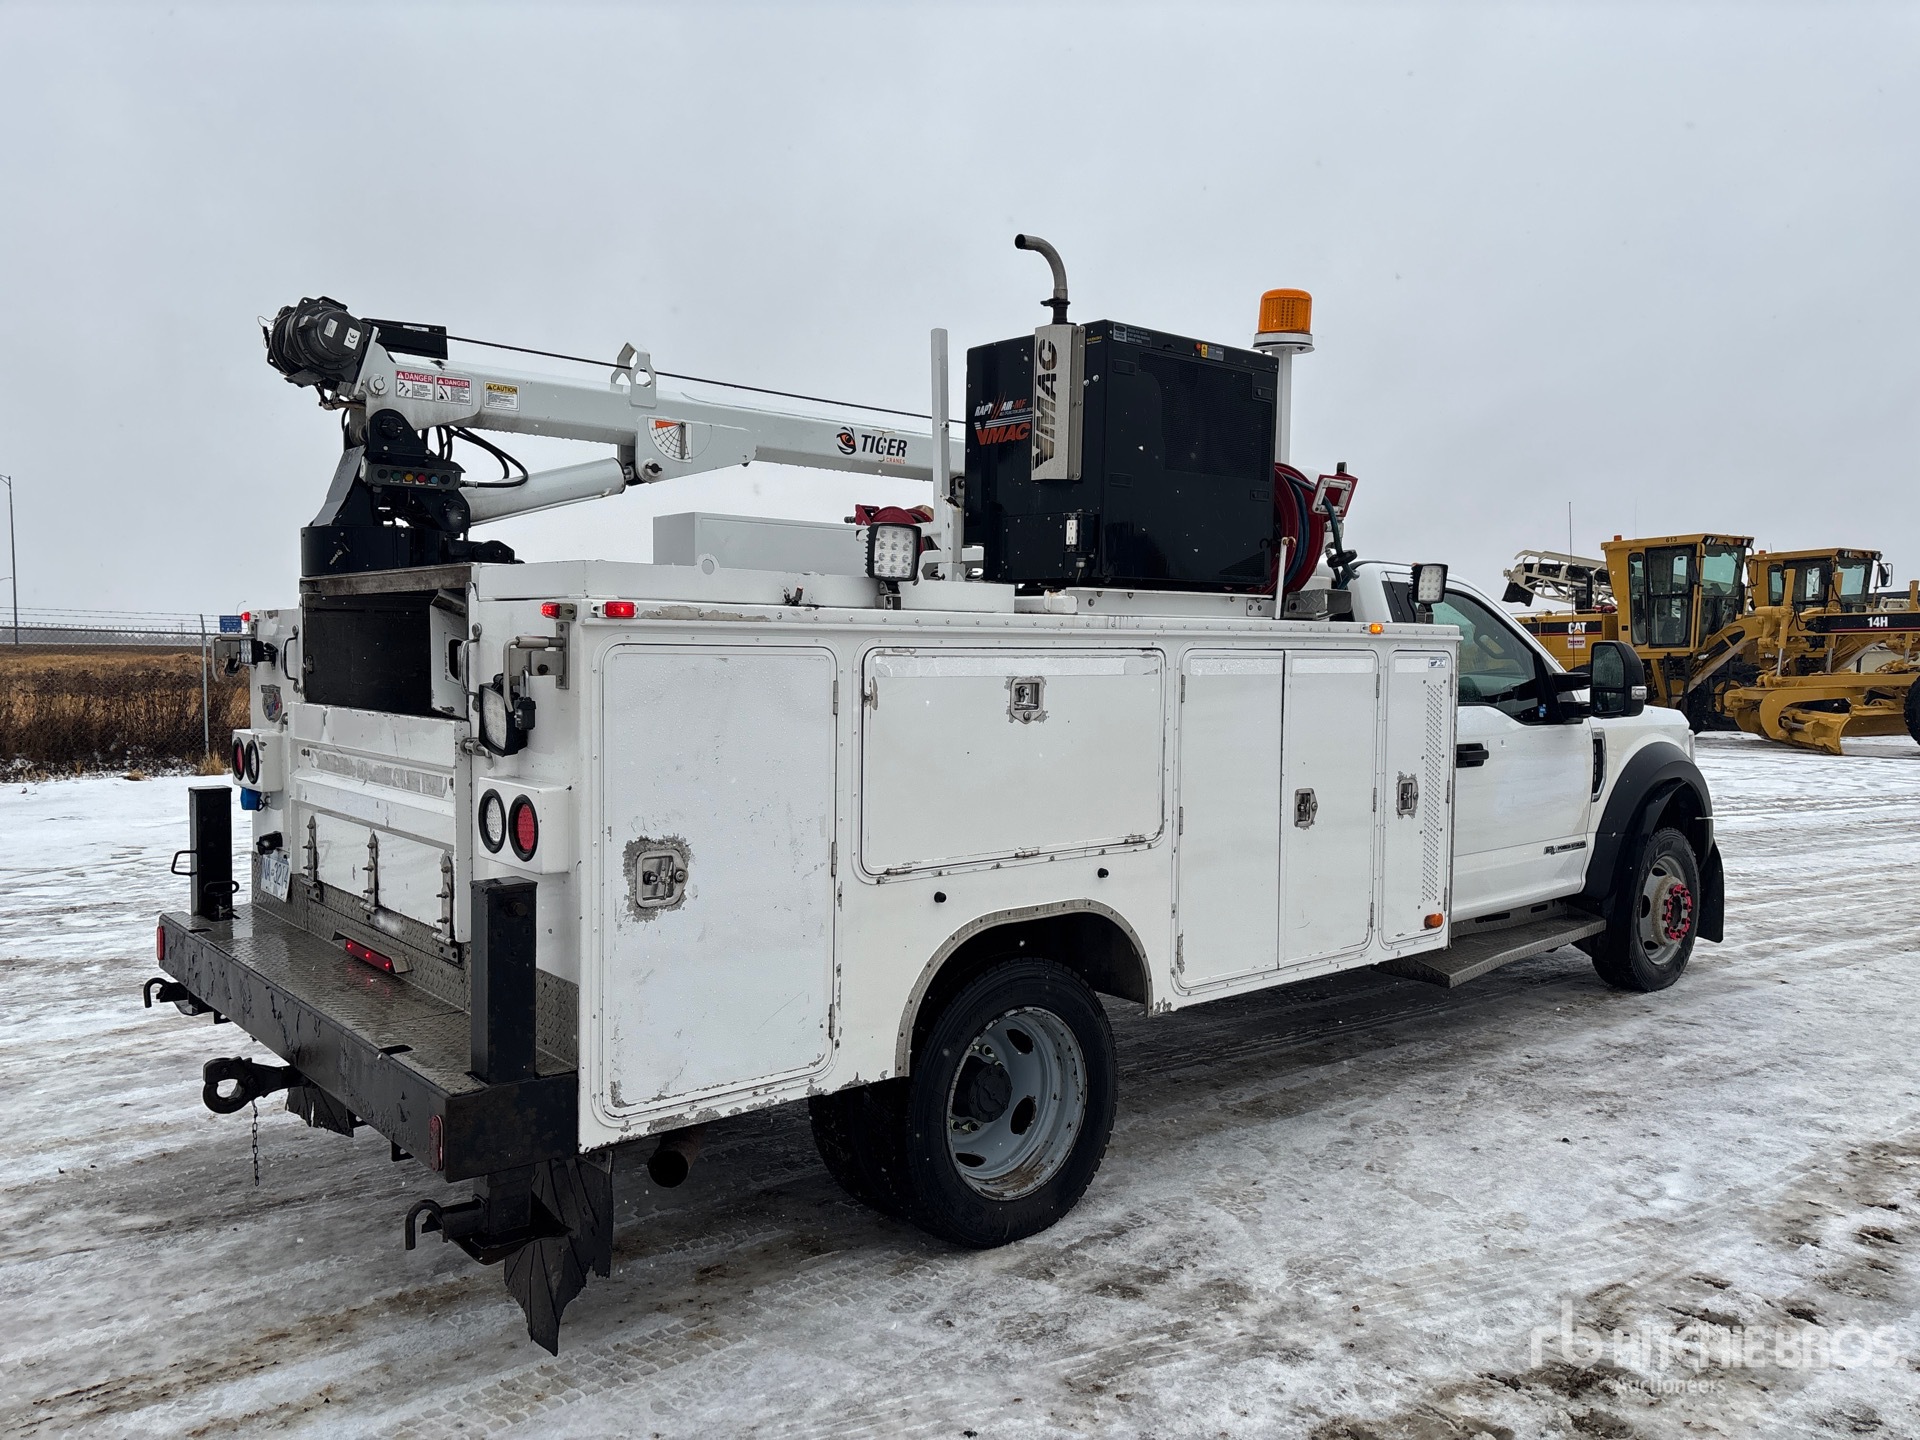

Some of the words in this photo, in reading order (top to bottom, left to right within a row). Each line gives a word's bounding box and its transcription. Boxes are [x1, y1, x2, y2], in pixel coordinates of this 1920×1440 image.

[347, 332, 358, 344] CE
[404, 372, 433, 383] DANGER
[444, 380, 469, 388] DANGER
[492, 383, 517, 393] CAUTION
[1033, 338, 1058, 470] VMAC
[974, 422, 1031, 446] VMAC
[861, 434, 907, 457] TIGER
[886, 457, 906, 465] CRANES
[1867, 616, 1889, 628] 14H
[1568, 622, 1587, 635] CAT
